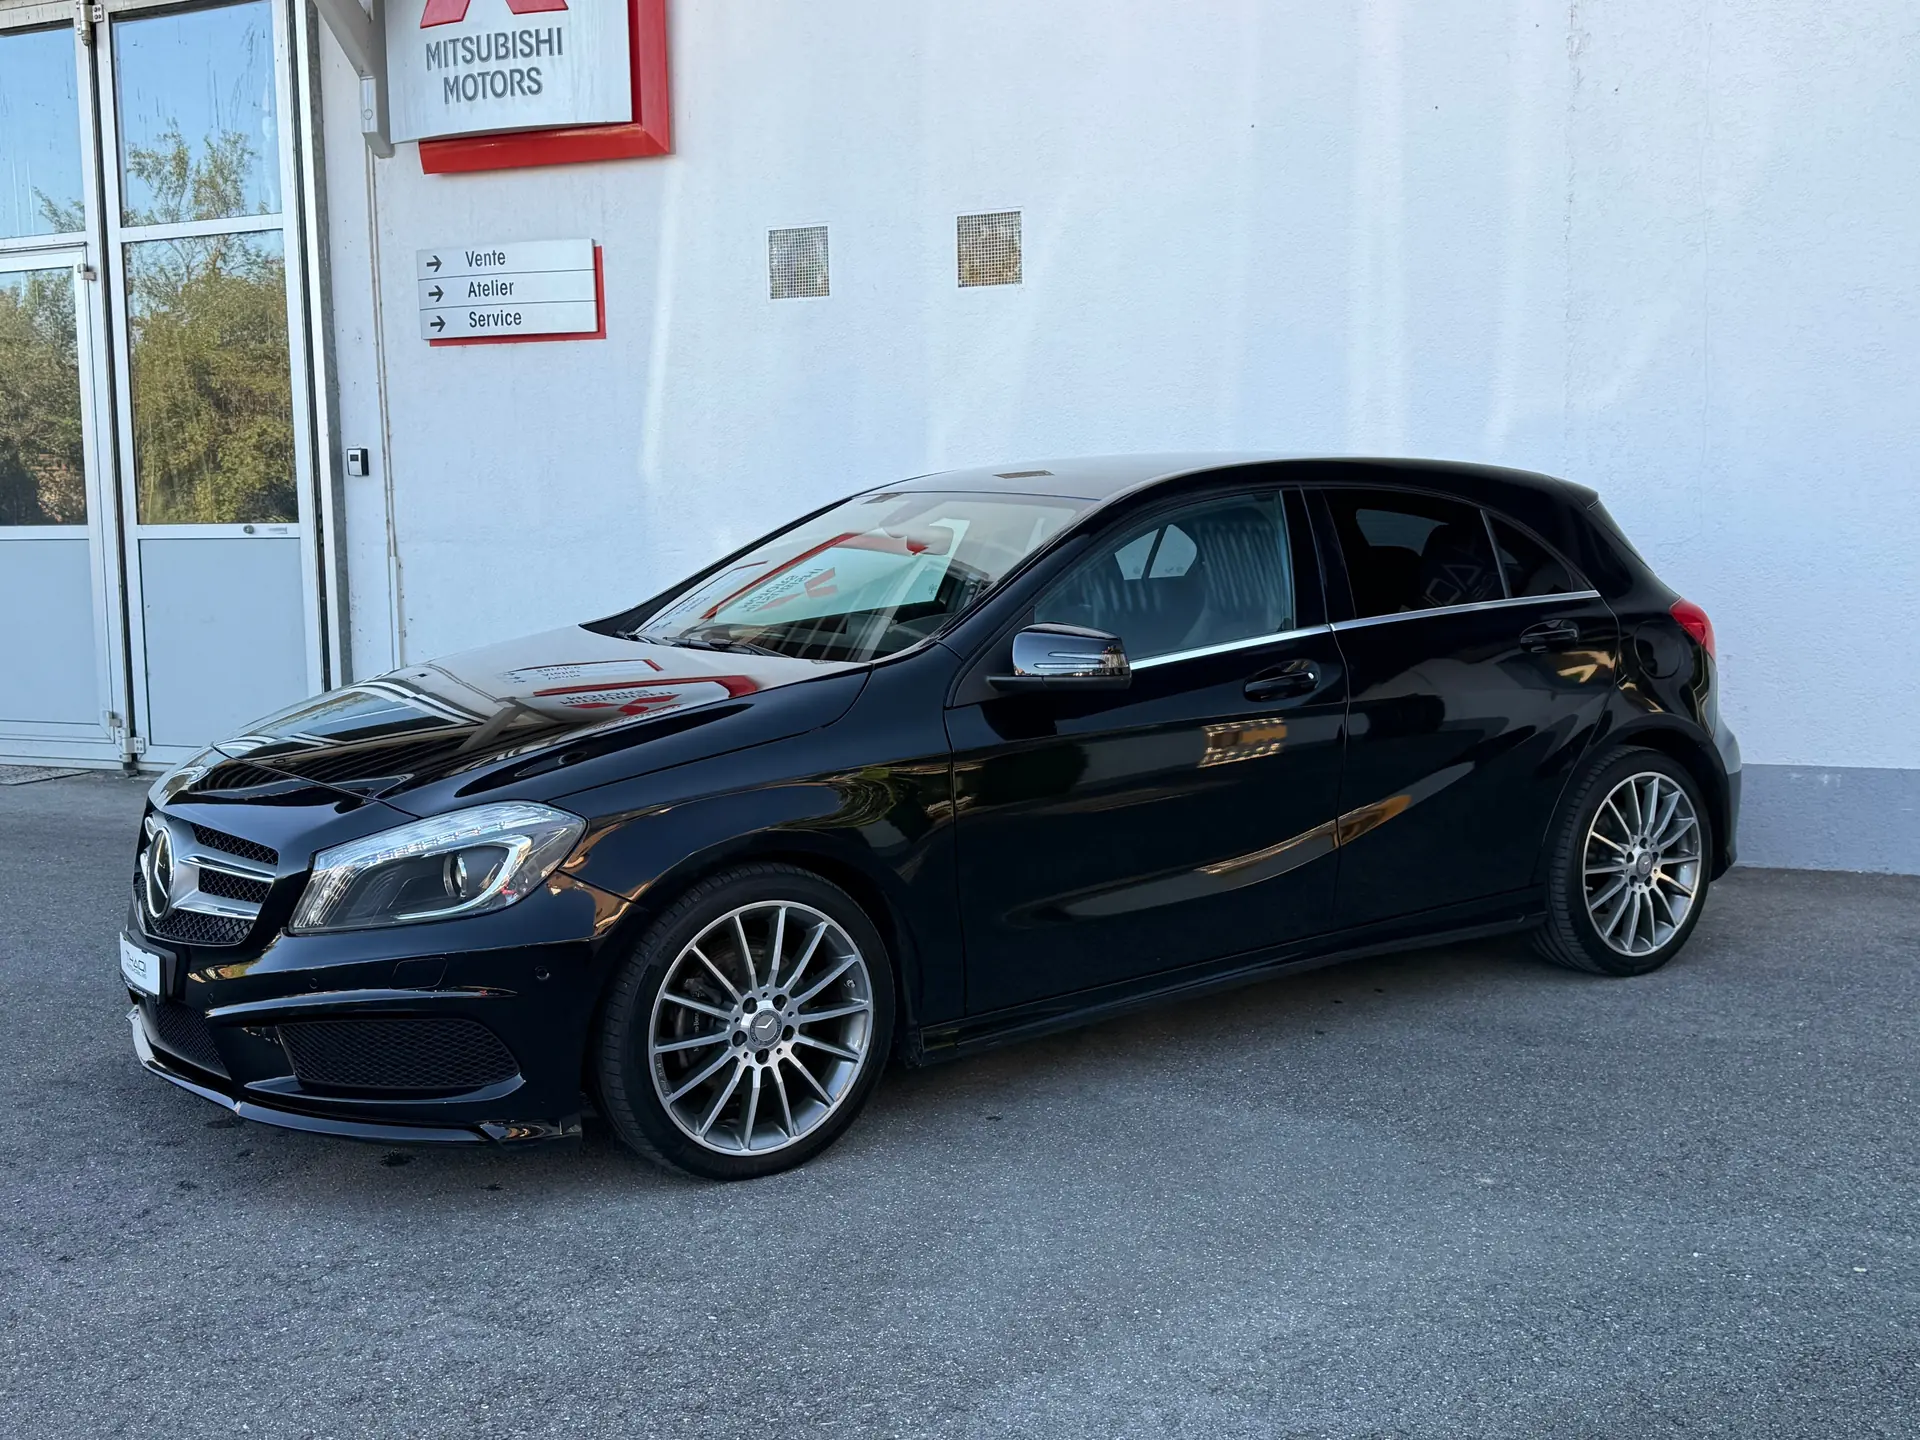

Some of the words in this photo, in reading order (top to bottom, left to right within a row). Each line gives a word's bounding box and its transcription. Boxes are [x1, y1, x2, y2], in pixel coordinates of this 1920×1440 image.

[425, 27, 563, 71] MITSUBISHI
[443, 66, 543, 105] MOTORS
[465, 250, 506, 267] Vente
[468, 279, 514, 298] Atelier
[469, 309, 522, 328] Service
